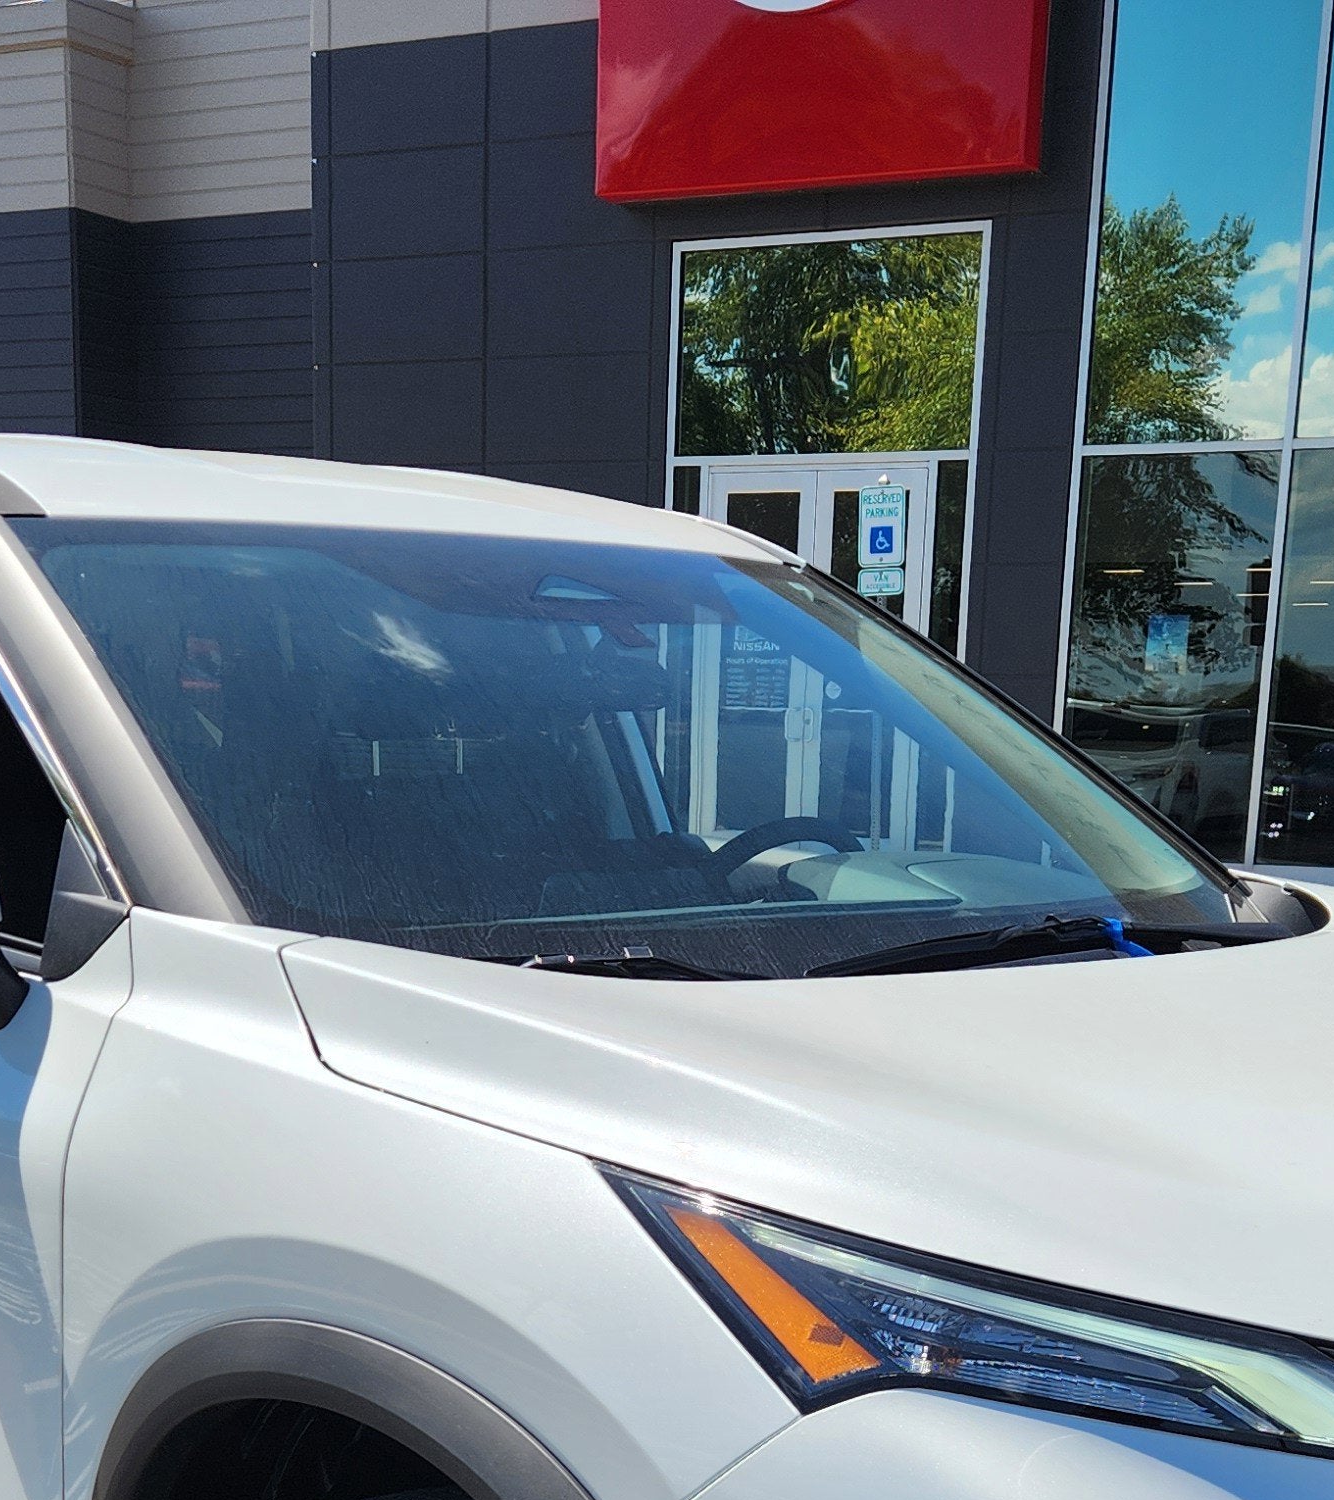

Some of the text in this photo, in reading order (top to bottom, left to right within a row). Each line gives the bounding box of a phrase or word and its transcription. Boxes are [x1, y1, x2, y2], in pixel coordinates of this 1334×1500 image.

[863, 493, 902, 505] RESERVED
[865, 507, 899, 518] PARKING
[733, 641, 779, 651] NISSAN
